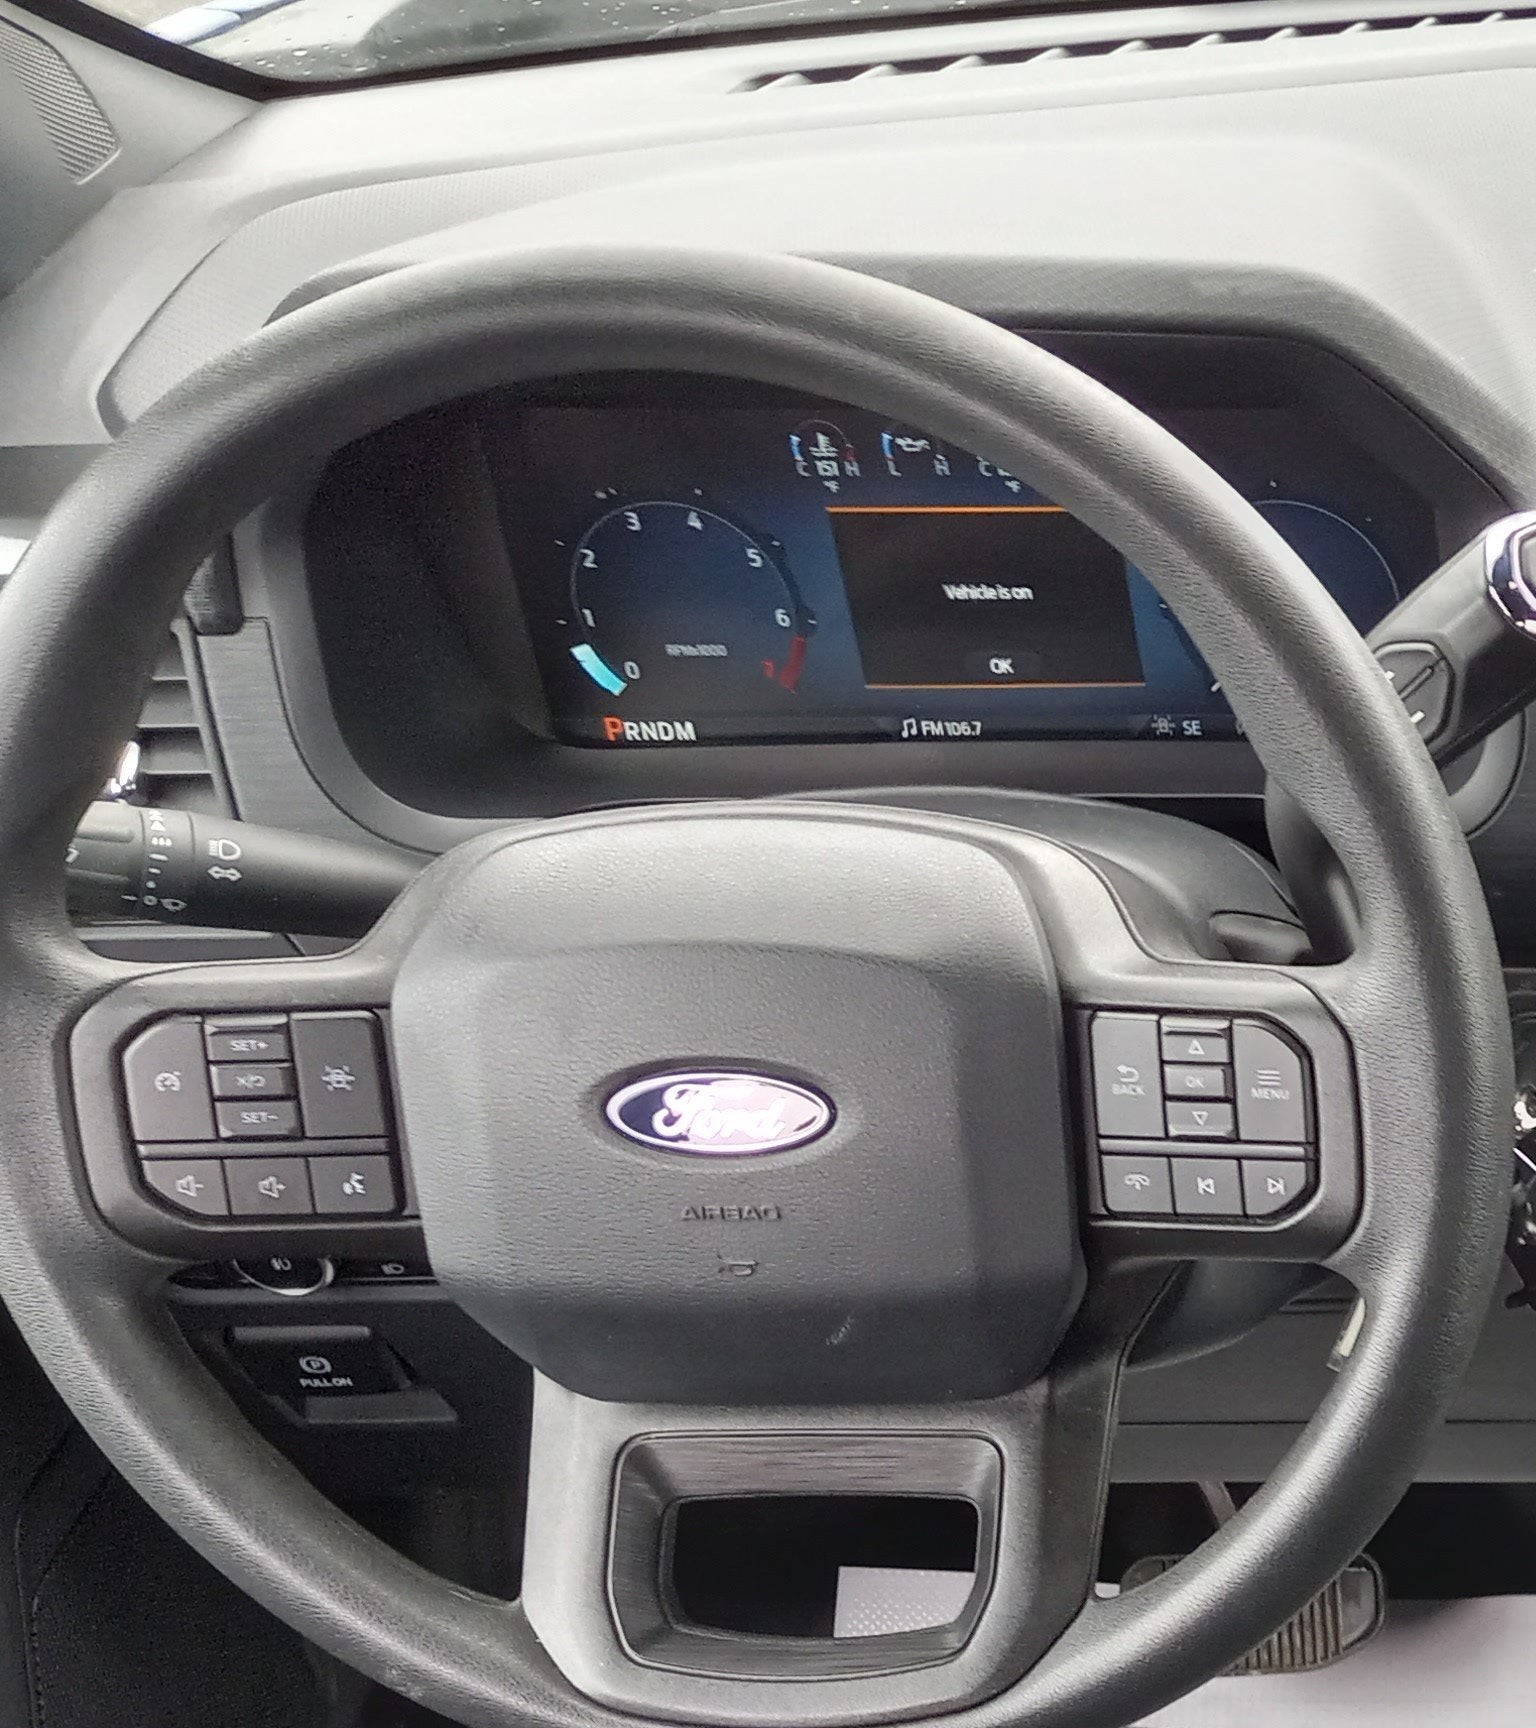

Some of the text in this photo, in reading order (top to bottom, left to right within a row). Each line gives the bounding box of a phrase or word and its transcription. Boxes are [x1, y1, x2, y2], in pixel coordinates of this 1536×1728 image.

[624, 511, 641, 531] 3
[687, 511, 703, 531] 4
[580, 549, 598, 569] 2
[745, 548, 763, 568] 5
[942, 583, 1034, 600] Vehicle is on
[581, 608, 596, 628] 1
[774, 608, 791, 628] 6
[624, 661, 640, 680] 0
[989, 658, 1014, 675] OK
[921, 721, 982, 737] FM 106.7
[1182, 720, 1202, 735] SE
[1112, 1084, 1146, 1096] BACK
[1251, 1088, 1290, 1100] MENU
